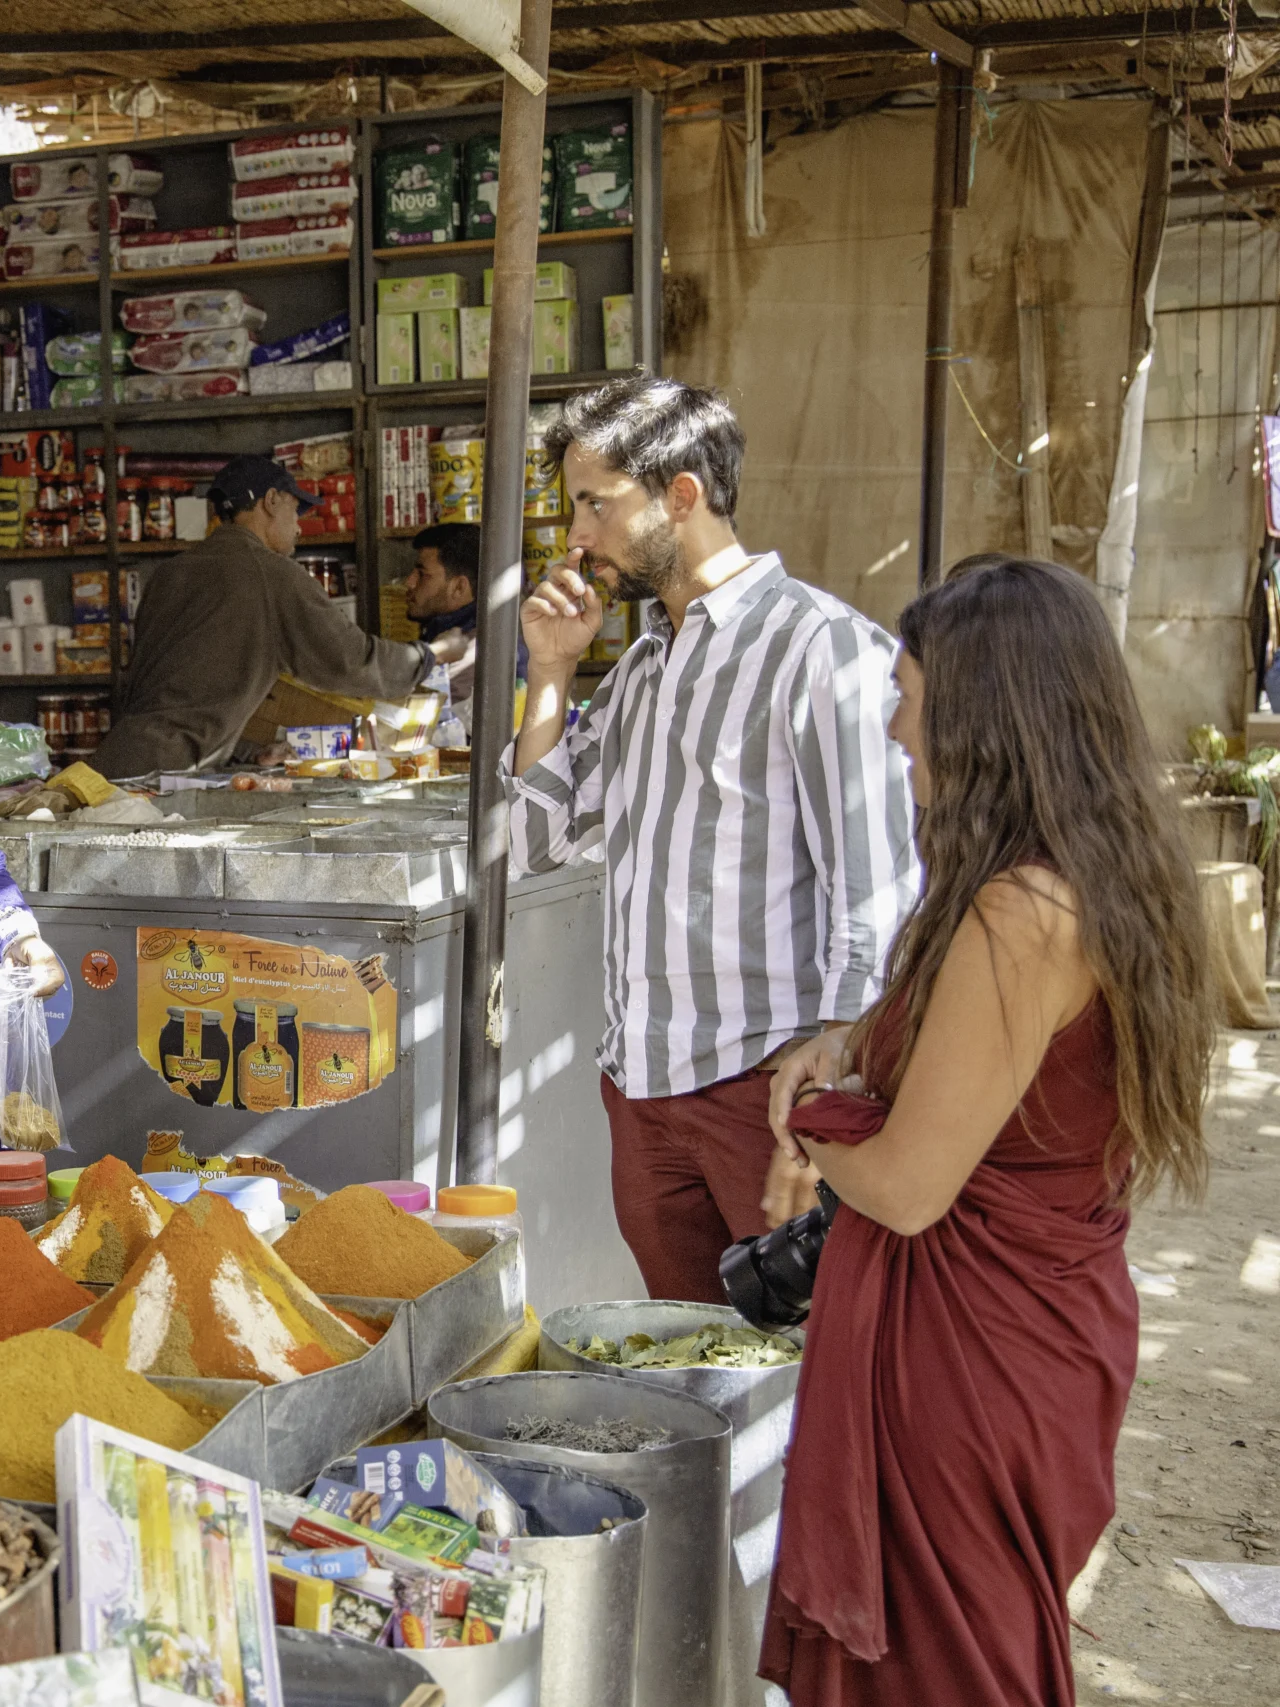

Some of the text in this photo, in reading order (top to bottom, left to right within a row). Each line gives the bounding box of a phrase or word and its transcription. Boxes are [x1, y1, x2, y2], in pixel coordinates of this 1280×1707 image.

[391, 192, 437, 212] Nova
[243, 950, 278, 973] Force
[300, 953, 349, 978] Nature
[165, 968, 225, 984] AL JANOUB
[232, 976, 291, 988] Miel d'eucalyptus
[168, 981, 222, 994] عسل الجنوب
[43, 1011, 65, 1020] ntact
[319, 1486, 339, 1511] RICE
